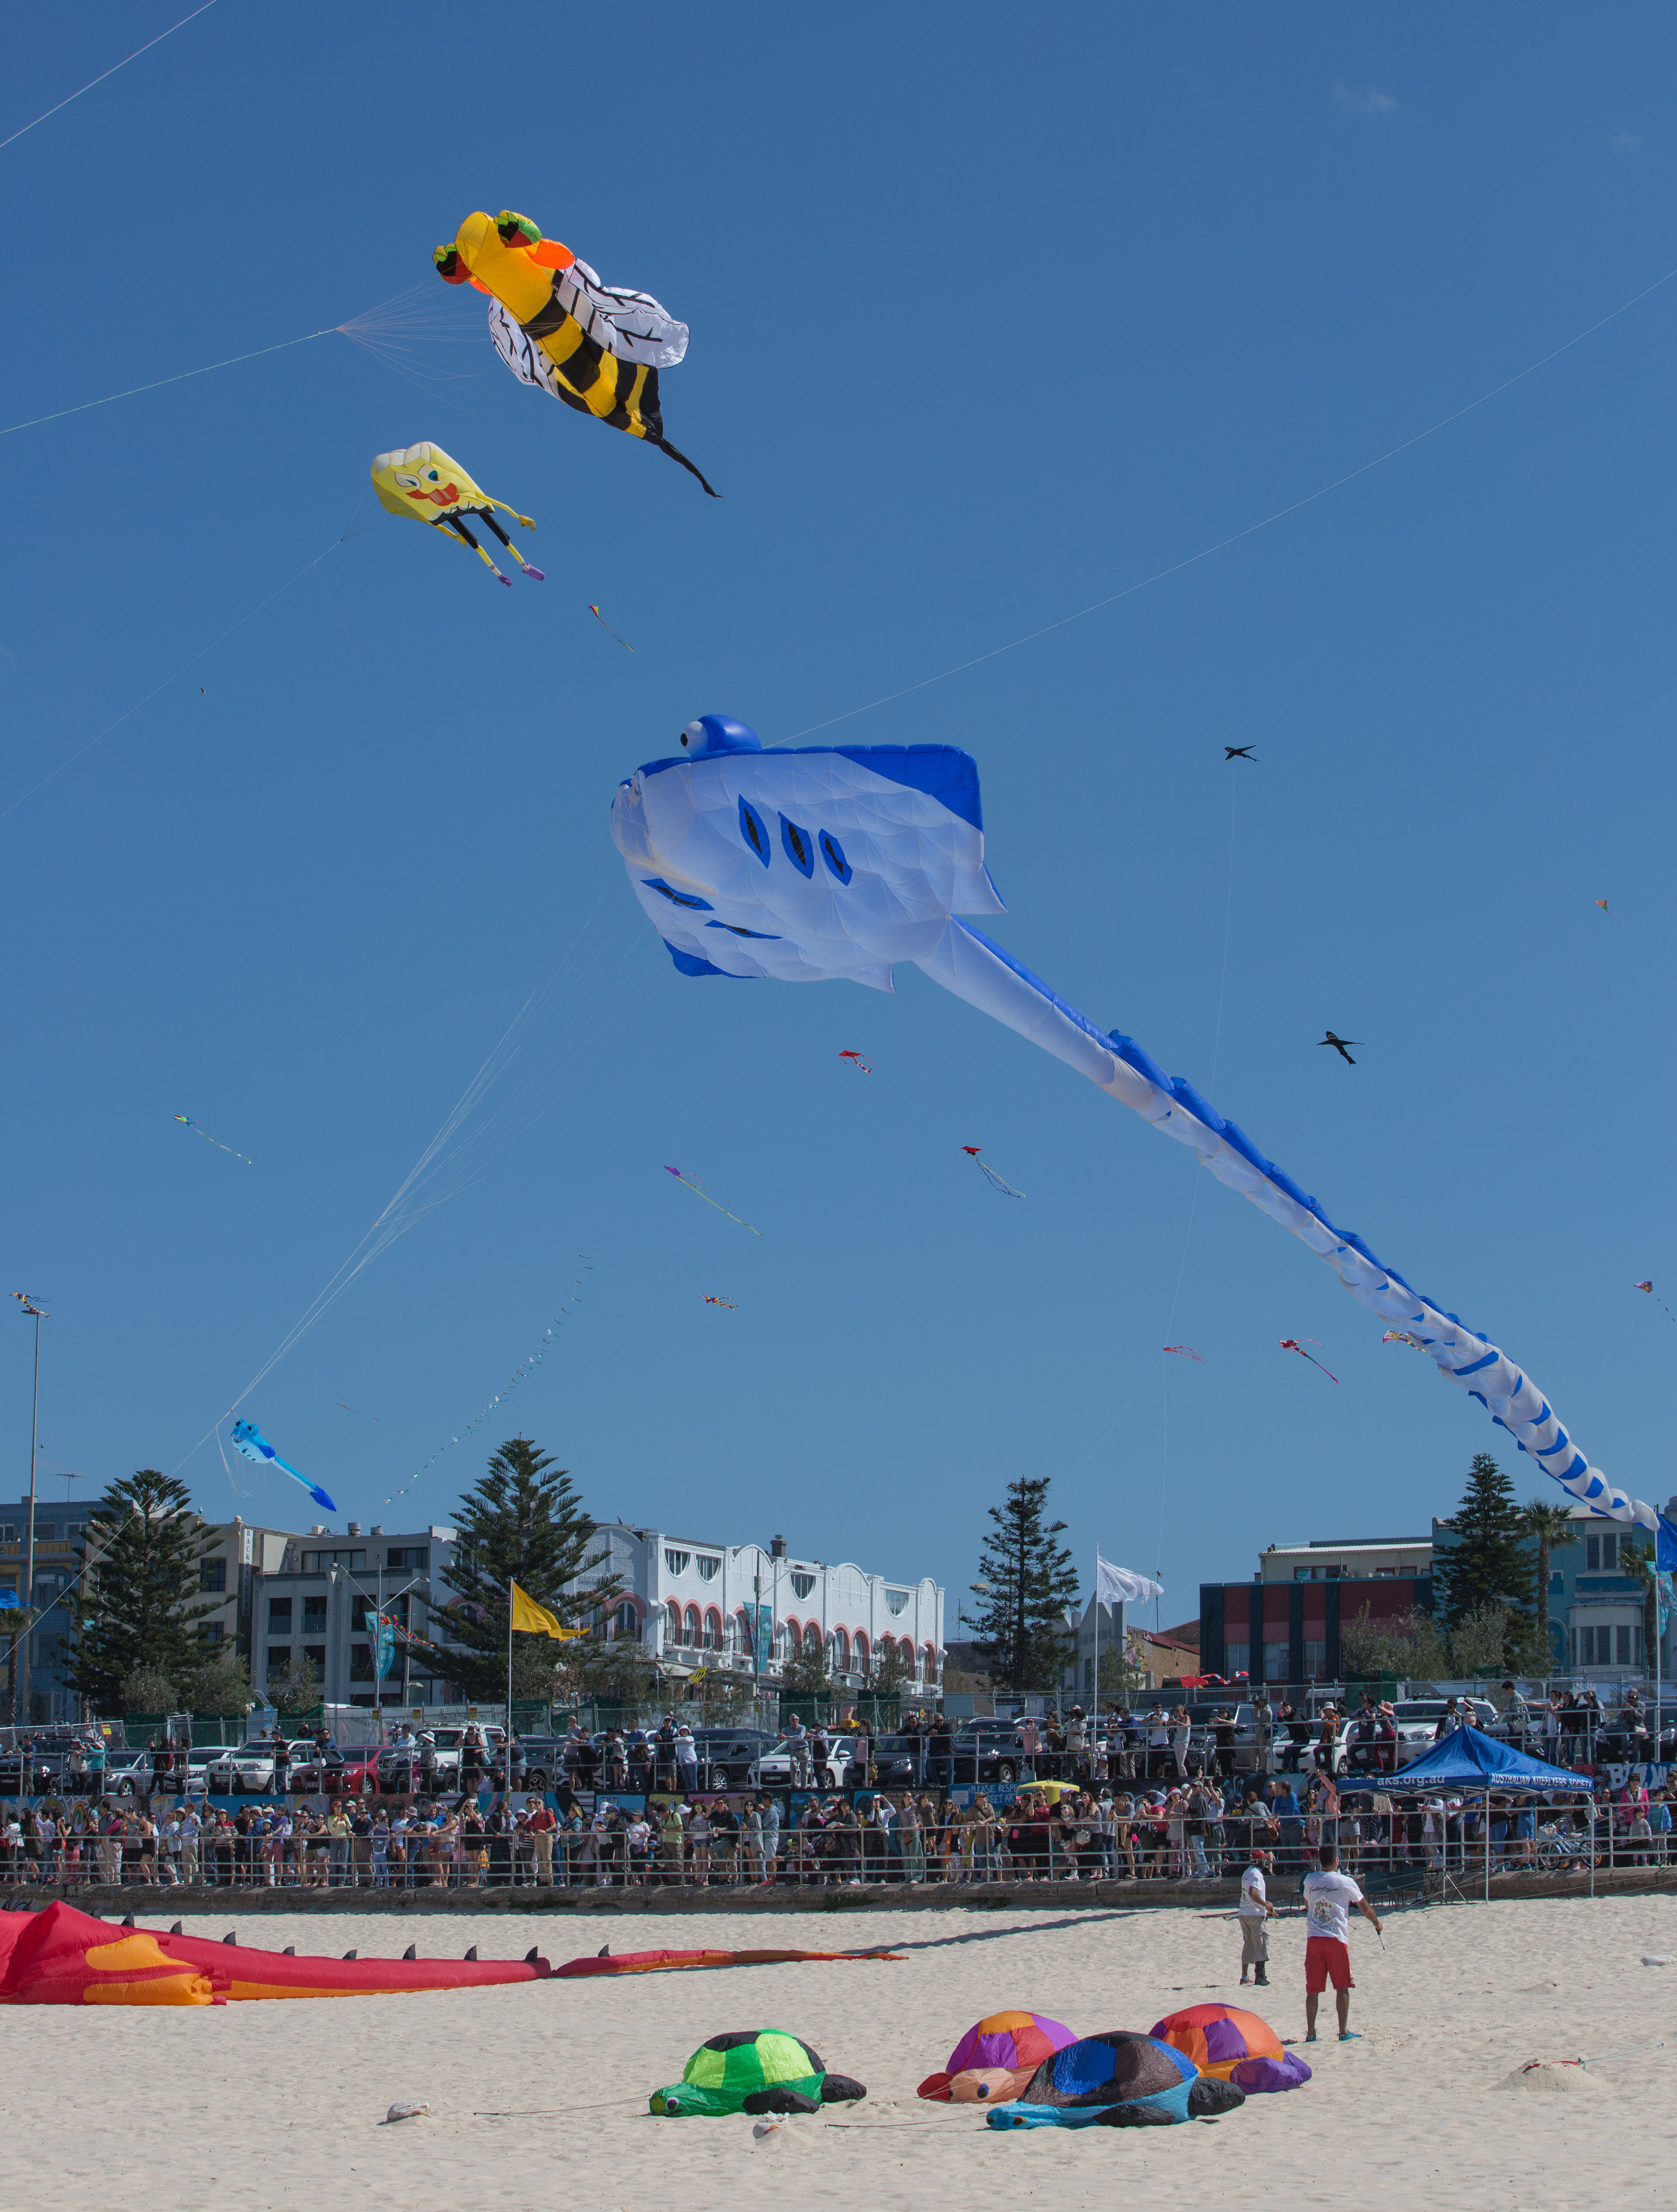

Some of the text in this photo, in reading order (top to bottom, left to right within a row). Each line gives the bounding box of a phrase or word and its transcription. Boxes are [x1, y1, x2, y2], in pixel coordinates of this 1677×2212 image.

[1377, 1776, 1445, 1786] aks.org.au
[1491, 1773, 1592, 1788] AUSTRALIAN KITEFLYERS SOCIETY
[971, 1784, 1022, 1794] PLEASE RESPE
[986, 1794, 1003, 1804] REET
